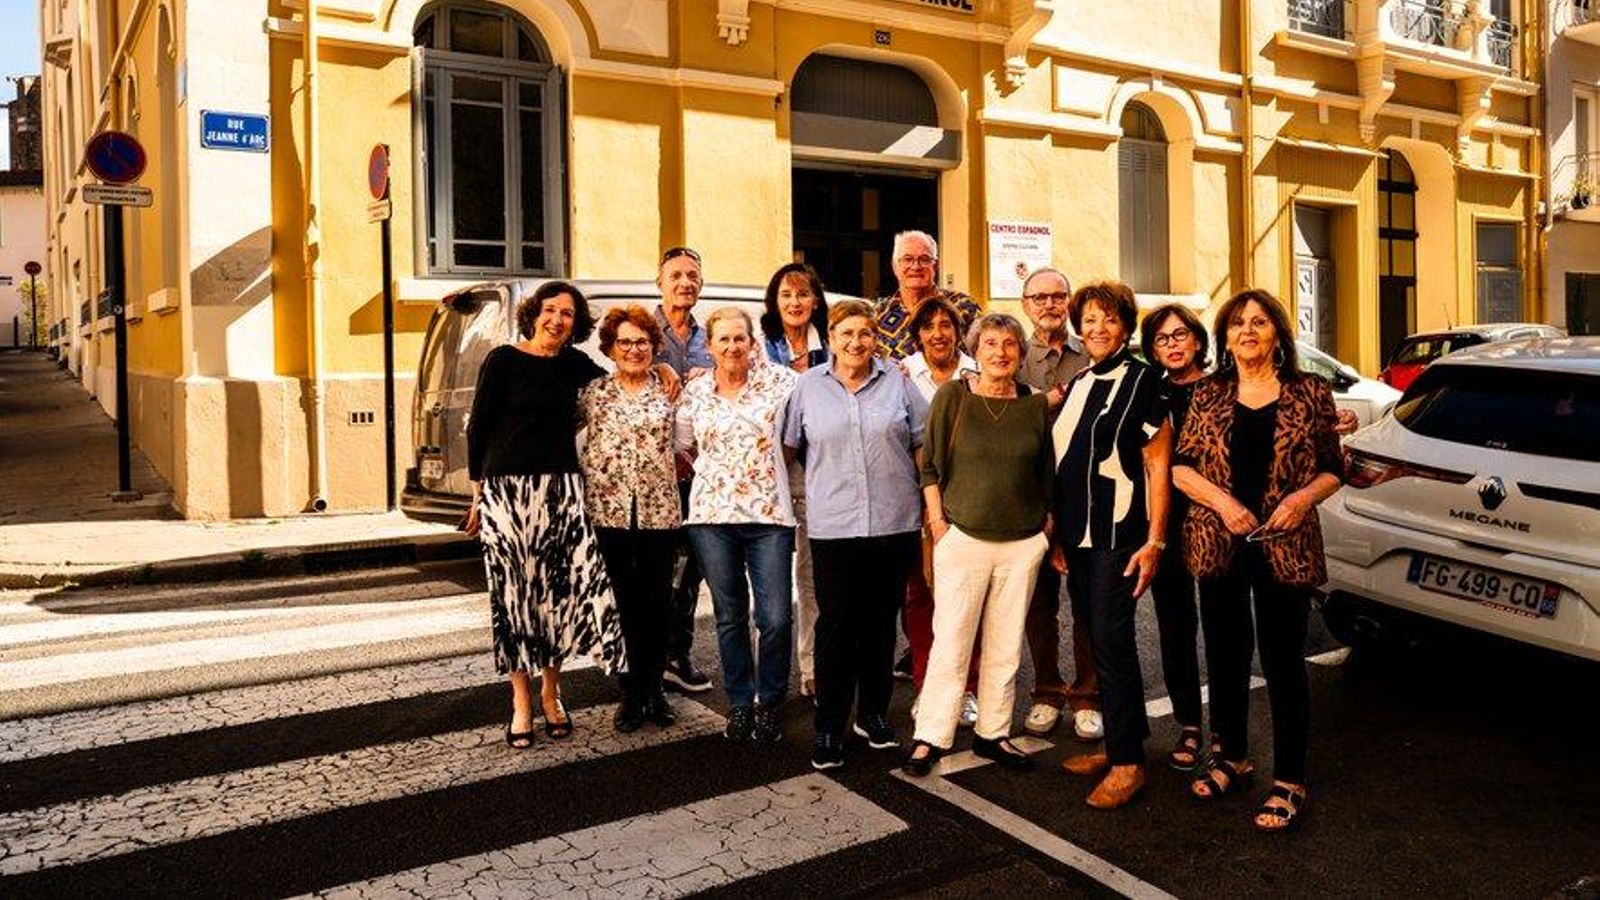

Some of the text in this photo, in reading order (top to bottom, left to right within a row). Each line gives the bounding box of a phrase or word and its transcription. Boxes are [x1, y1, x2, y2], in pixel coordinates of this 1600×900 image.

[227, 118, 245, 130] RUE
[205, 130, 239, 143] JEANNE
[990, 223, 1051, 236] CENTRO ESPAGNOL
[1448, 508, 1531, 533] MEGANE
